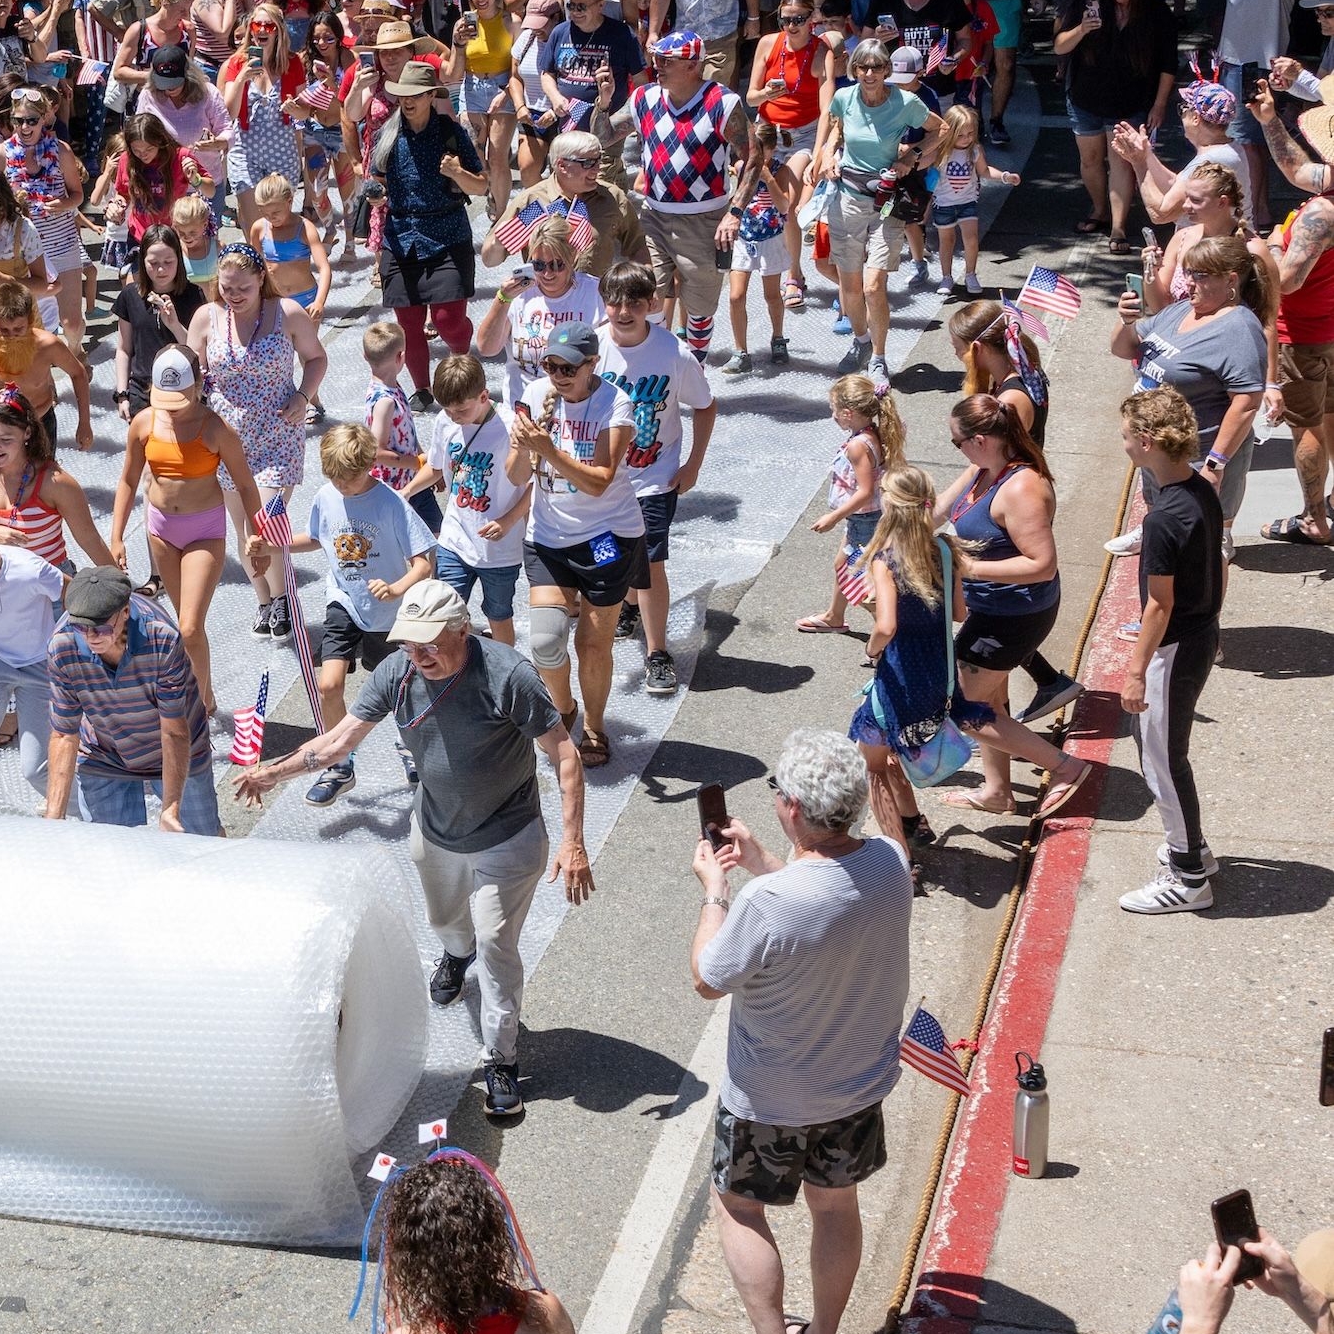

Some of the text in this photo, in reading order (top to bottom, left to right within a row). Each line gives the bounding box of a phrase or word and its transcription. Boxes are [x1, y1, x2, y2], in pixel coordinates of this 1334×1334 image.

[561, 419, 598, 442] CHILL
[574, 442, 595, 458] THE
[358, 520, 380, 536] WALL
